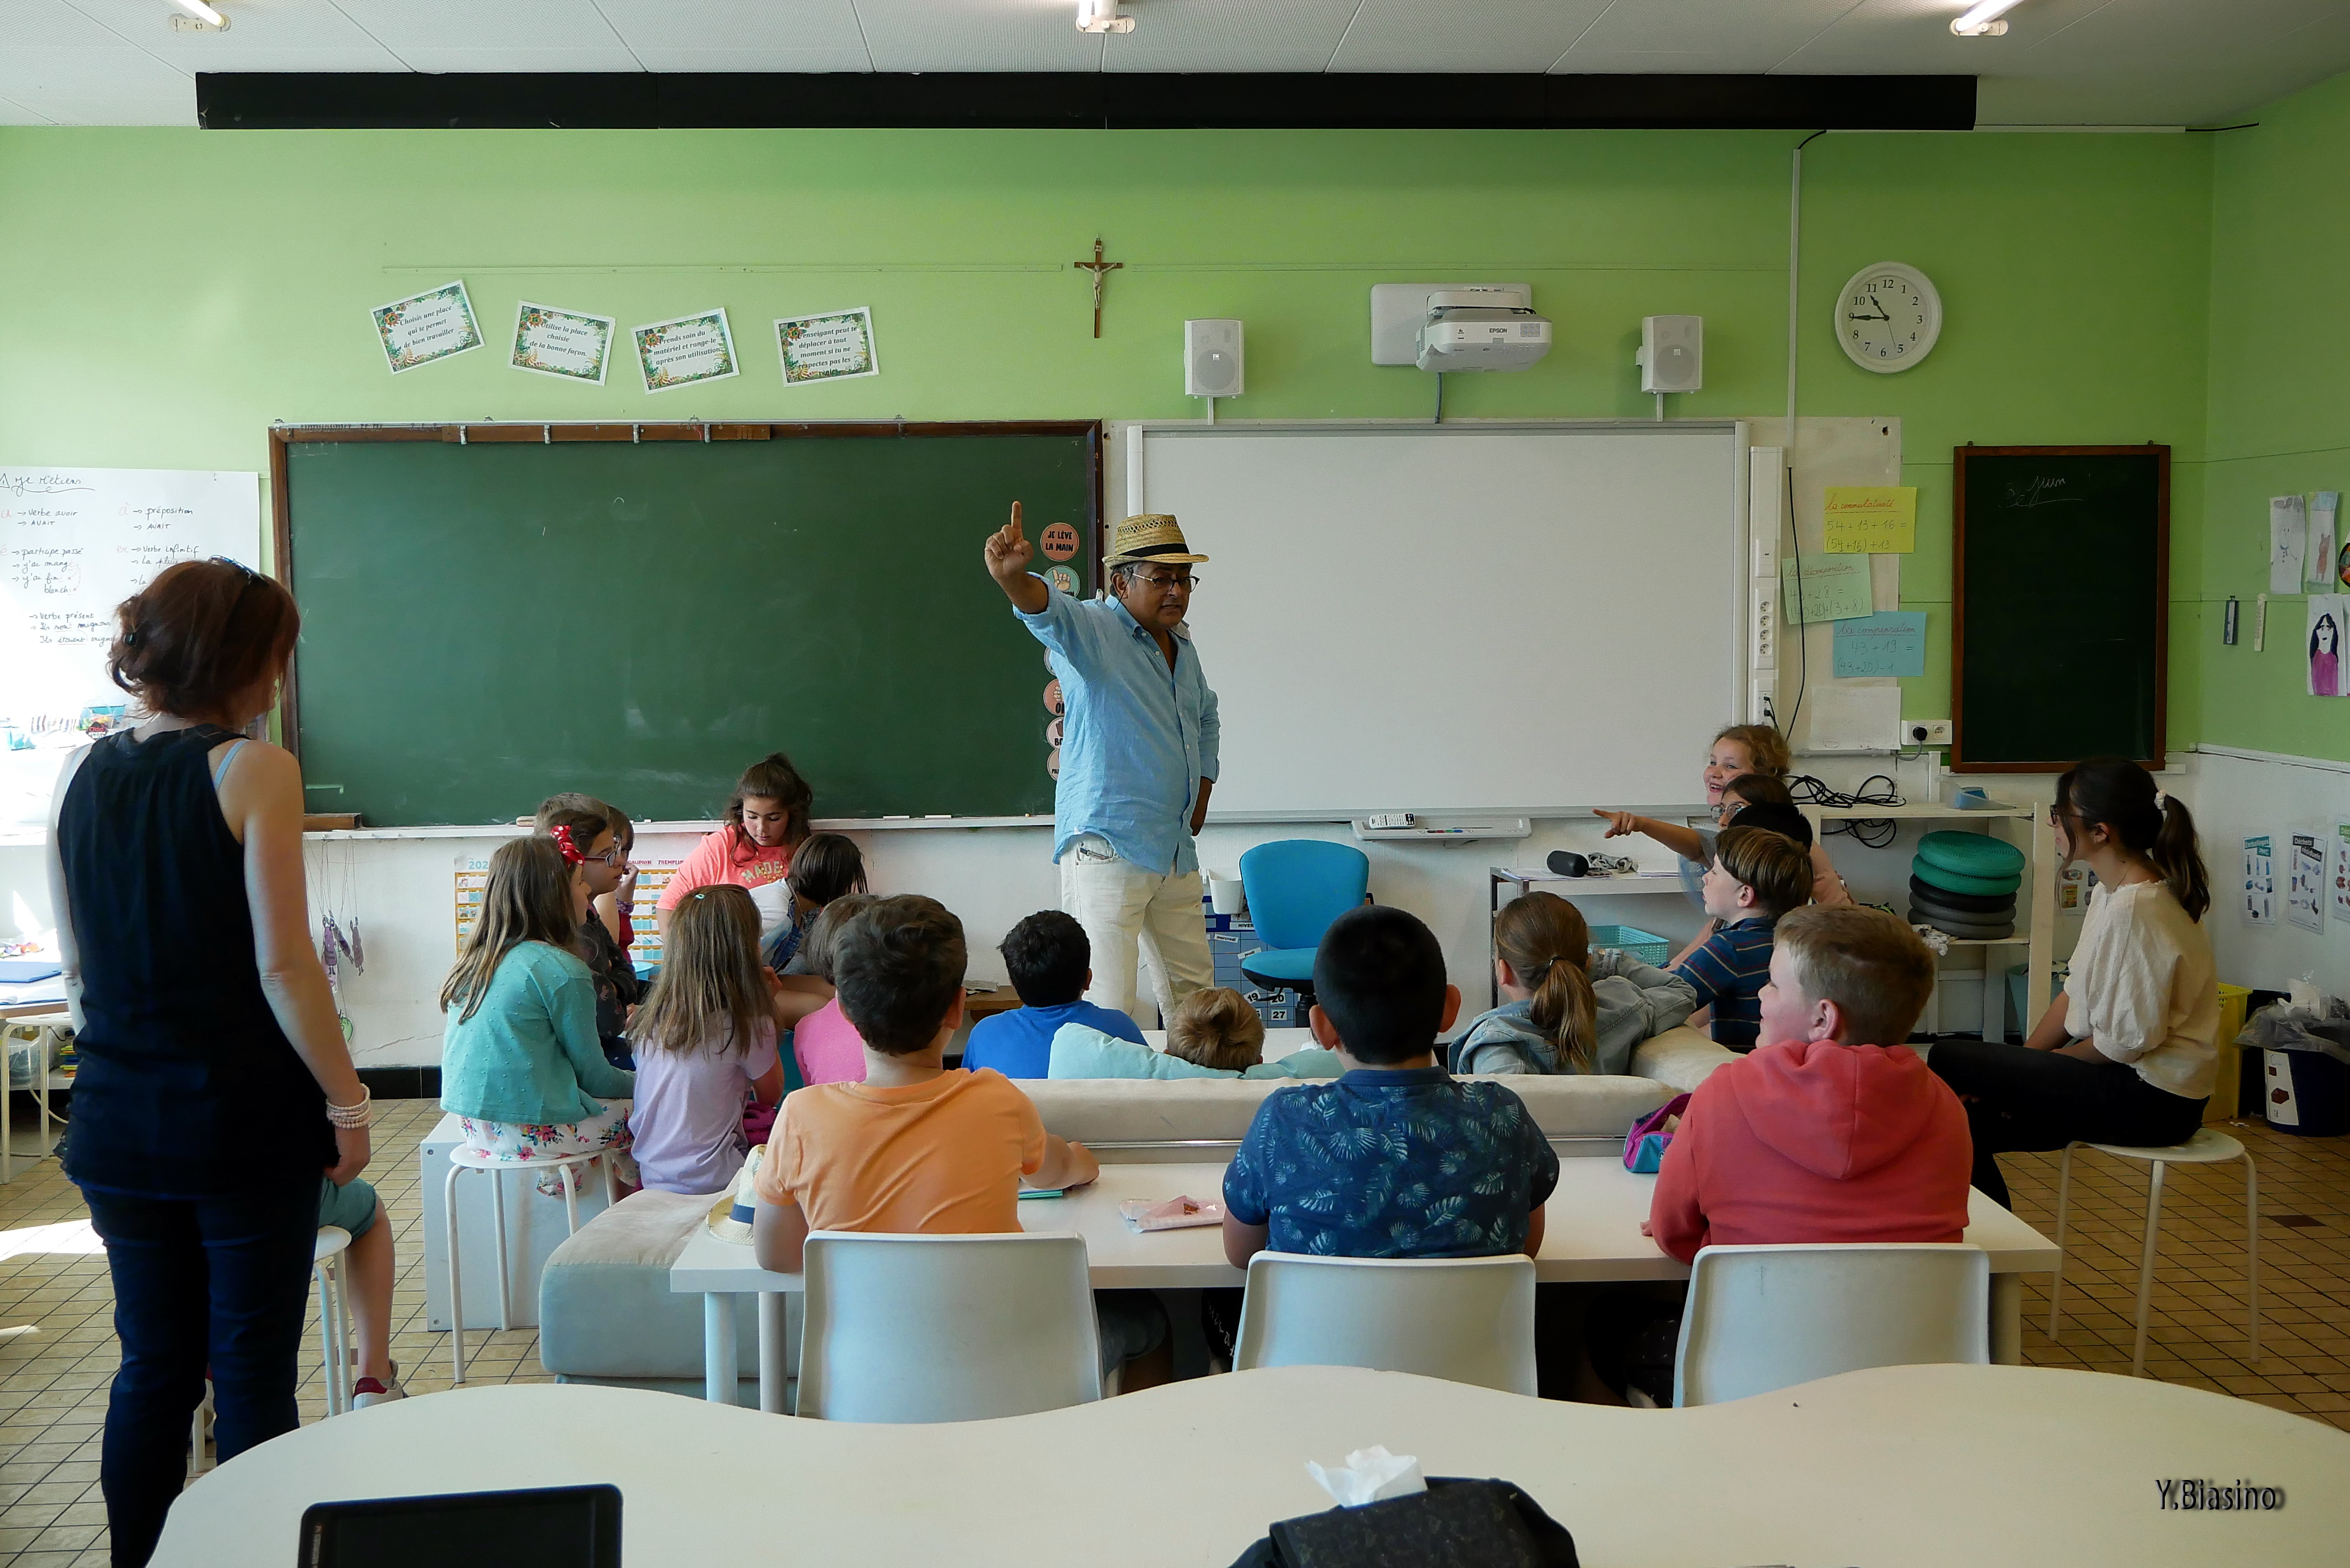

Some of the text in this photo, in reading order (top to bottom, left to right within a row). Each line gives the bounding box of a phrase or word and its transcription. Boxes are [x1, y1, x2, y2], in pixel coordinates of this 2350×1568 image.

[1866, 284, 1877, 293] 11
[1882, 279, 1894, 289] 12
[1901, 285, 1906, 294] 1
[1854, 296, 1865, 306] 10
[1912, 296, 1918, 306] 2
[400, 315, 422, 326] Choisis
[436, 306, 452, 316] place
[1848, 312, 1855, 321] 9
[1917, 315, 1923, 324] 3
[407, 327, 418, 336] qui
[426, 318, 446, 331] permet
[541, 323, 562, 331] Utilise
[570, 328, 588, 336] place
[427, 328, 454, 341] travailler
[547, 333, 570, 342] choisie
[1853, 330, 1859, 339] 8
[1910, 332, 1916, 341] 4
[659, 335, 682, 345] Prends
[799, 339, 827, 349] déplacer
[547, 343, 567, 353] bonne
[567, 347, 587, 357] façon.
[654, 344, 681, 356] matériel
[690, 337, 716, 347] range-le
[1864, 342, 1870, 351] 7
[1897, 343, 1904, 353] 5
[656, 357, 674, 365] après
[688, 347, 720, 358] utilisation
[800, 350, 826, 358] moment
[1880, 347, 1886, 357] 6
[798, 360, 828, 369] respectes
[145, 506, 193, 520] préposition
[1827, 520, 1845, 532] 54
[1857, 520, 1868, 531] 13
[1881, 519, 1895, 530] 16
[1048, 530, 1073, 540] JE LÈVE
[165, 543, 199, 559] infinitif
[1045, 542, 1074, 552] LA MAIN
[21, 547, 59, 560] participe
[62, 548, 84, 557] passé
[1815, 585, 1830, 599] 28
[66, 611, 94, 623] présent
[1851, 640, 1867, 655] 43
[1882, 640, 1897, 653] 19
[468, 861, 488, 869] 202
[742, 861, 781, 883] MADE
[1247, 992, 1259, 1002] 19
[1271, 994, 1285, 1003] 20
[1272, 1011, 1286, 1019] 27
